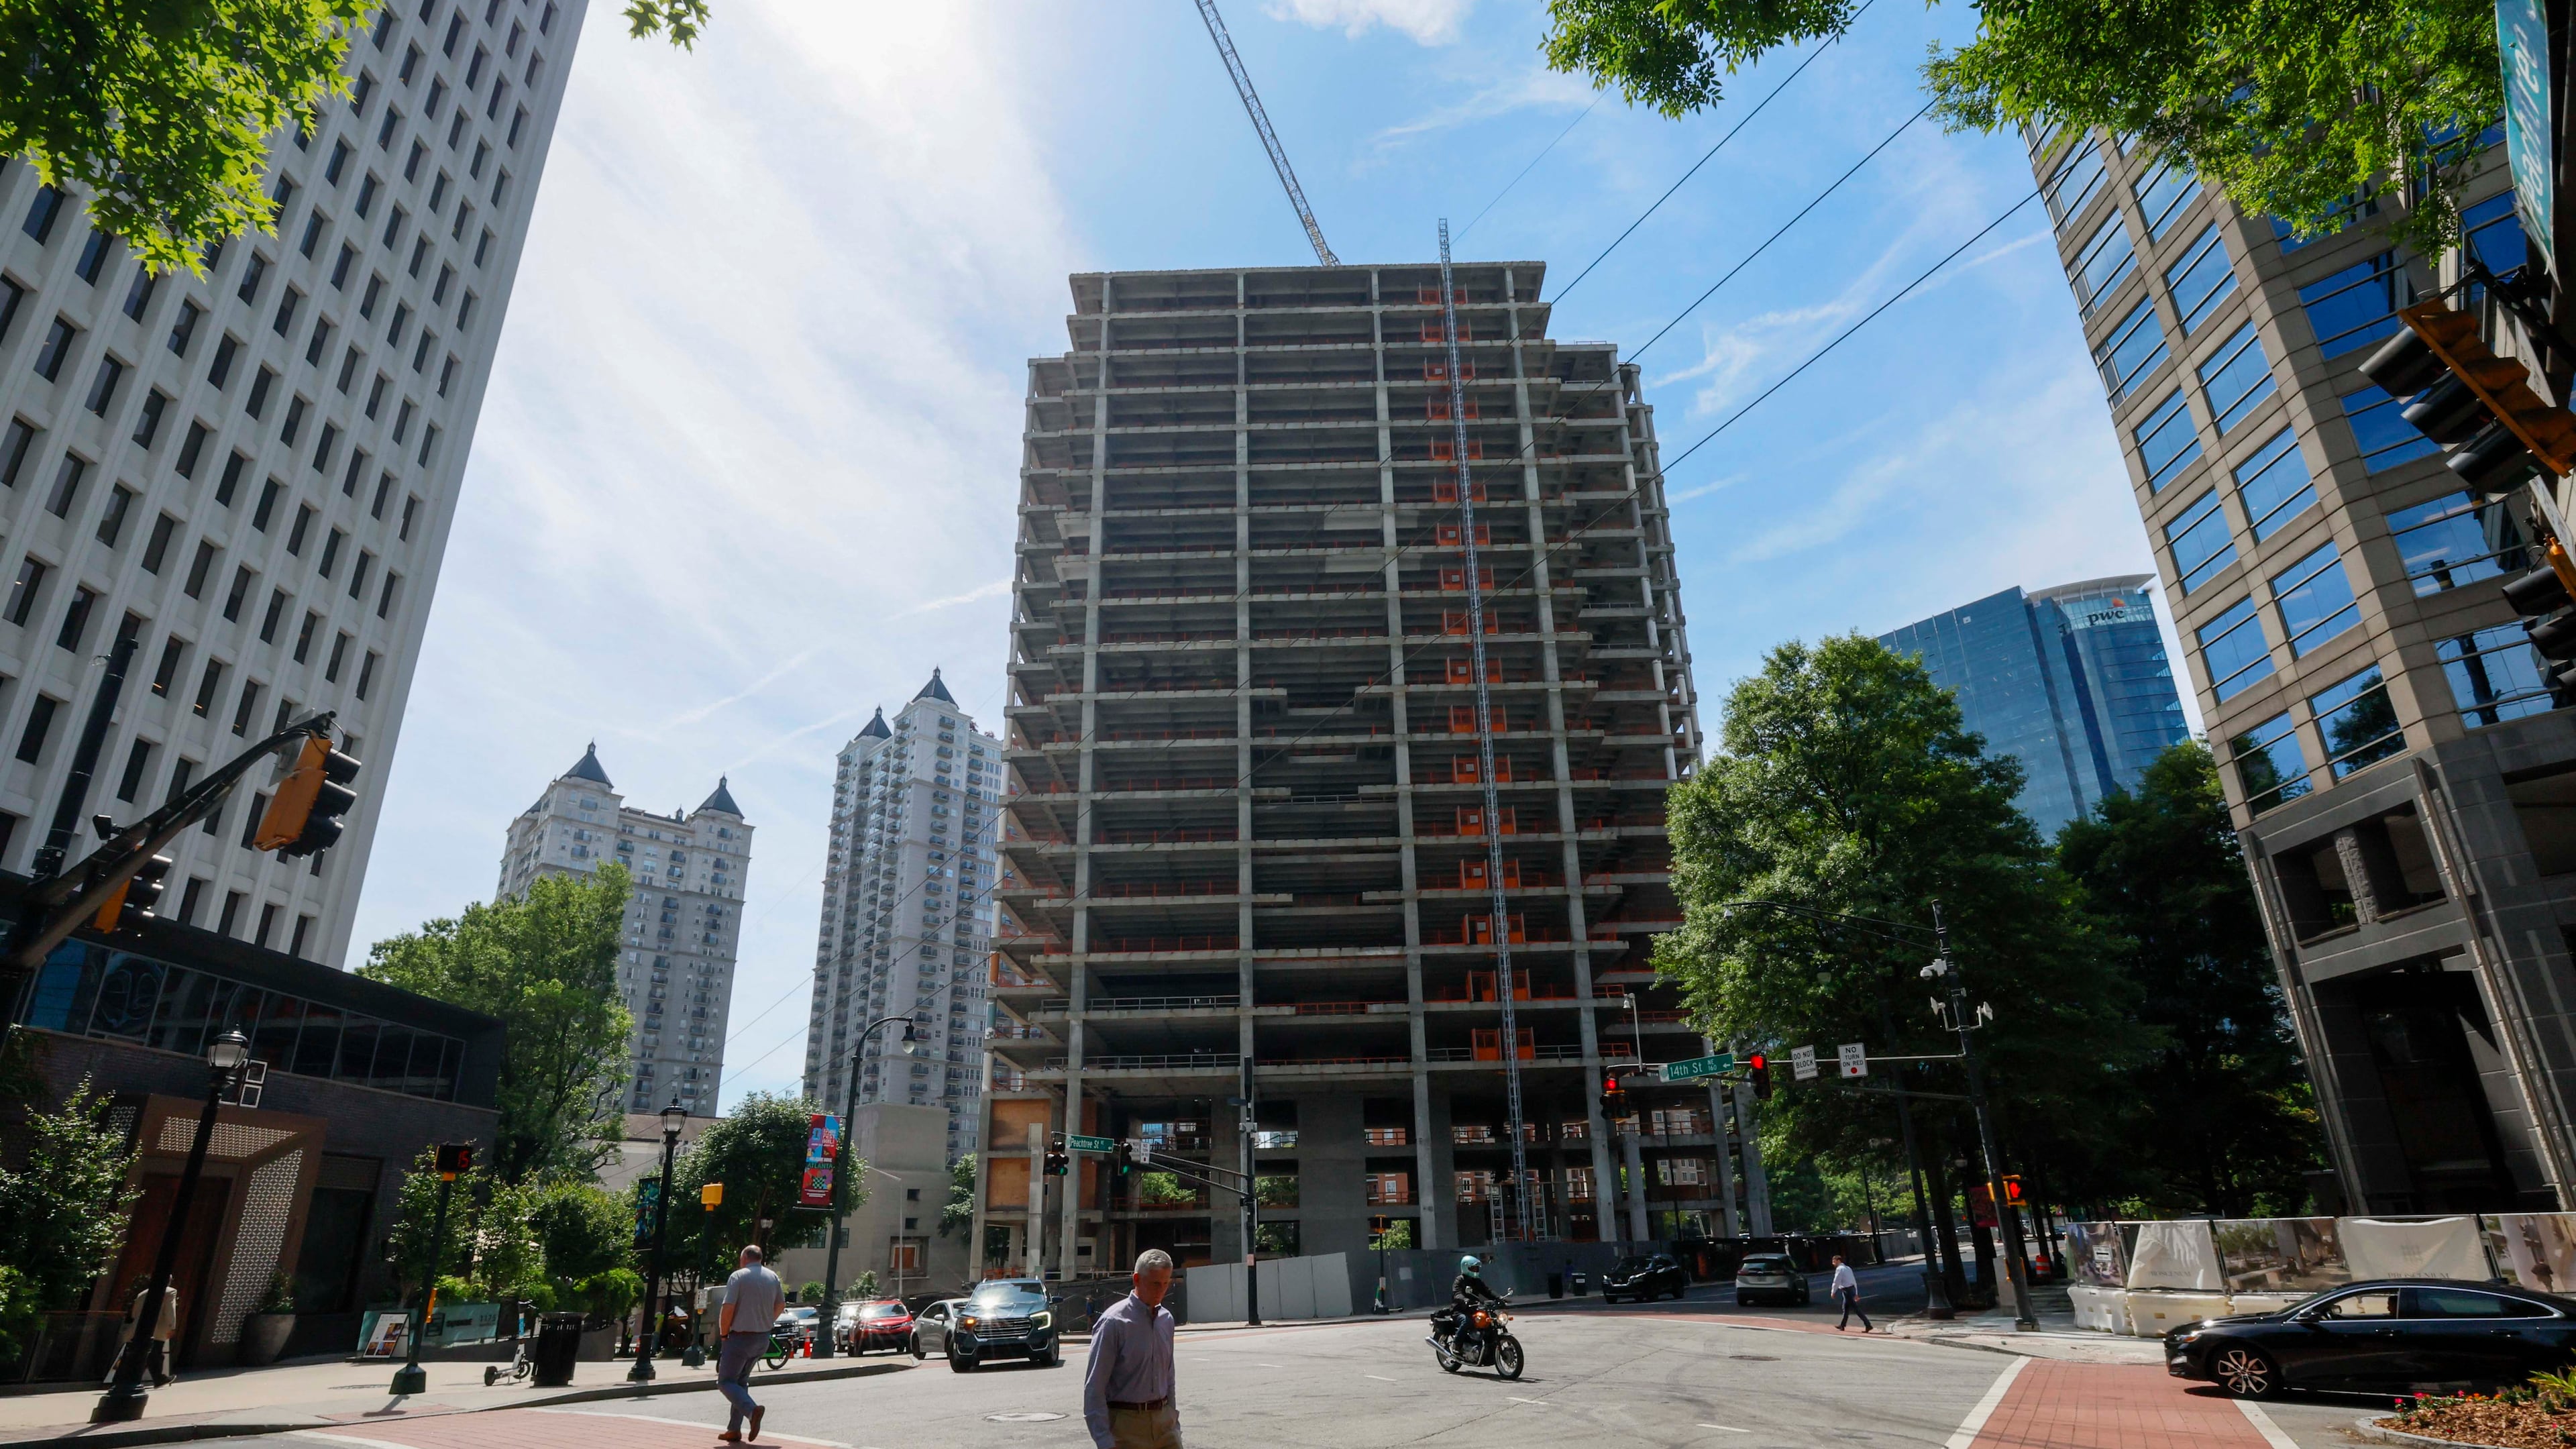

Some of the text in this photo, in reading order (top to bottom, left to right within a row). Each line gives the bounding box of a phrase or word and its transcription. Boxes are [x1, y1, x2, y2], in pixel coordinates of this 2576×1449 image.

[2086, 610, 2125, 627] pwc
[1803, 1050, 1813, 1058] NOT
[1670, 1062, 1703, 1077] 14th St
[1796, 1059, 1814, 1069] BLOCK
[1071, 1138, 1093, 1148] Peachtree
[1093, 1140, 1099, 1149] St
